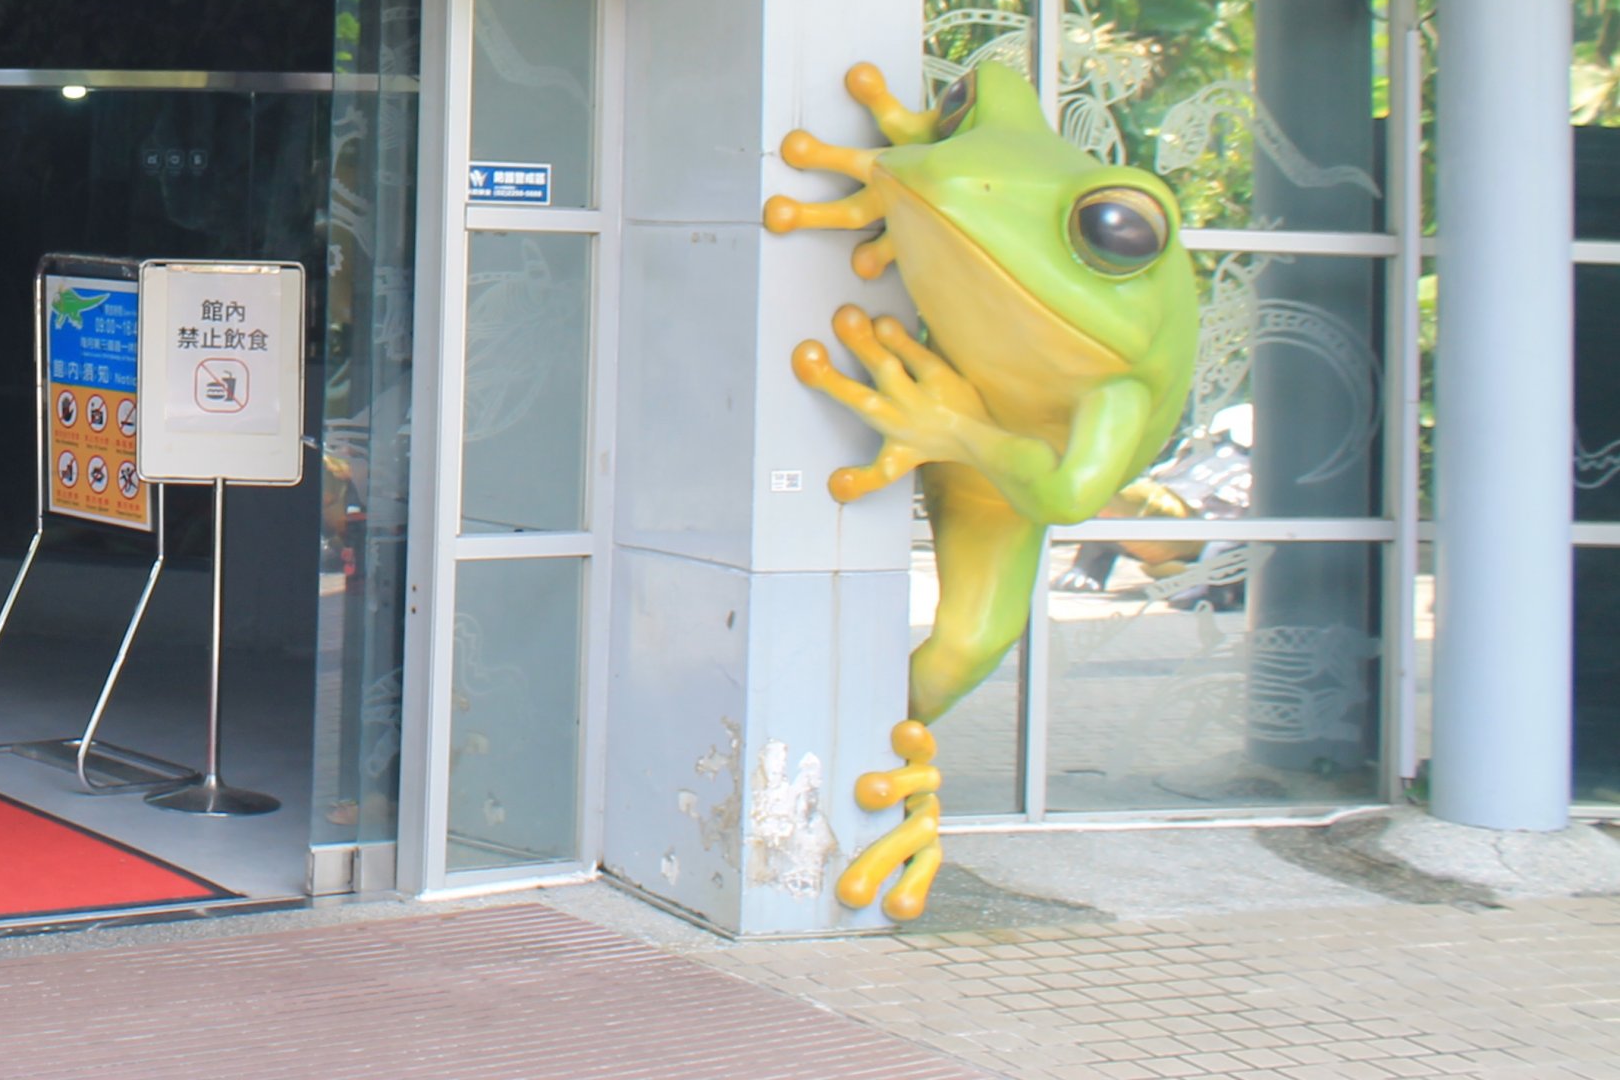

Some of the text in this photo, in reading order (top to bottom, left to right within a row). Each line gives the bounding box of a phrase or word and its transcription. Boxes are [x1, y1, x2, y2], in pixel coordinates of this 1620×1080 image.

[201, 299, 246, 322] 館內
[177, 326, 269, 352] 禁止飲食
